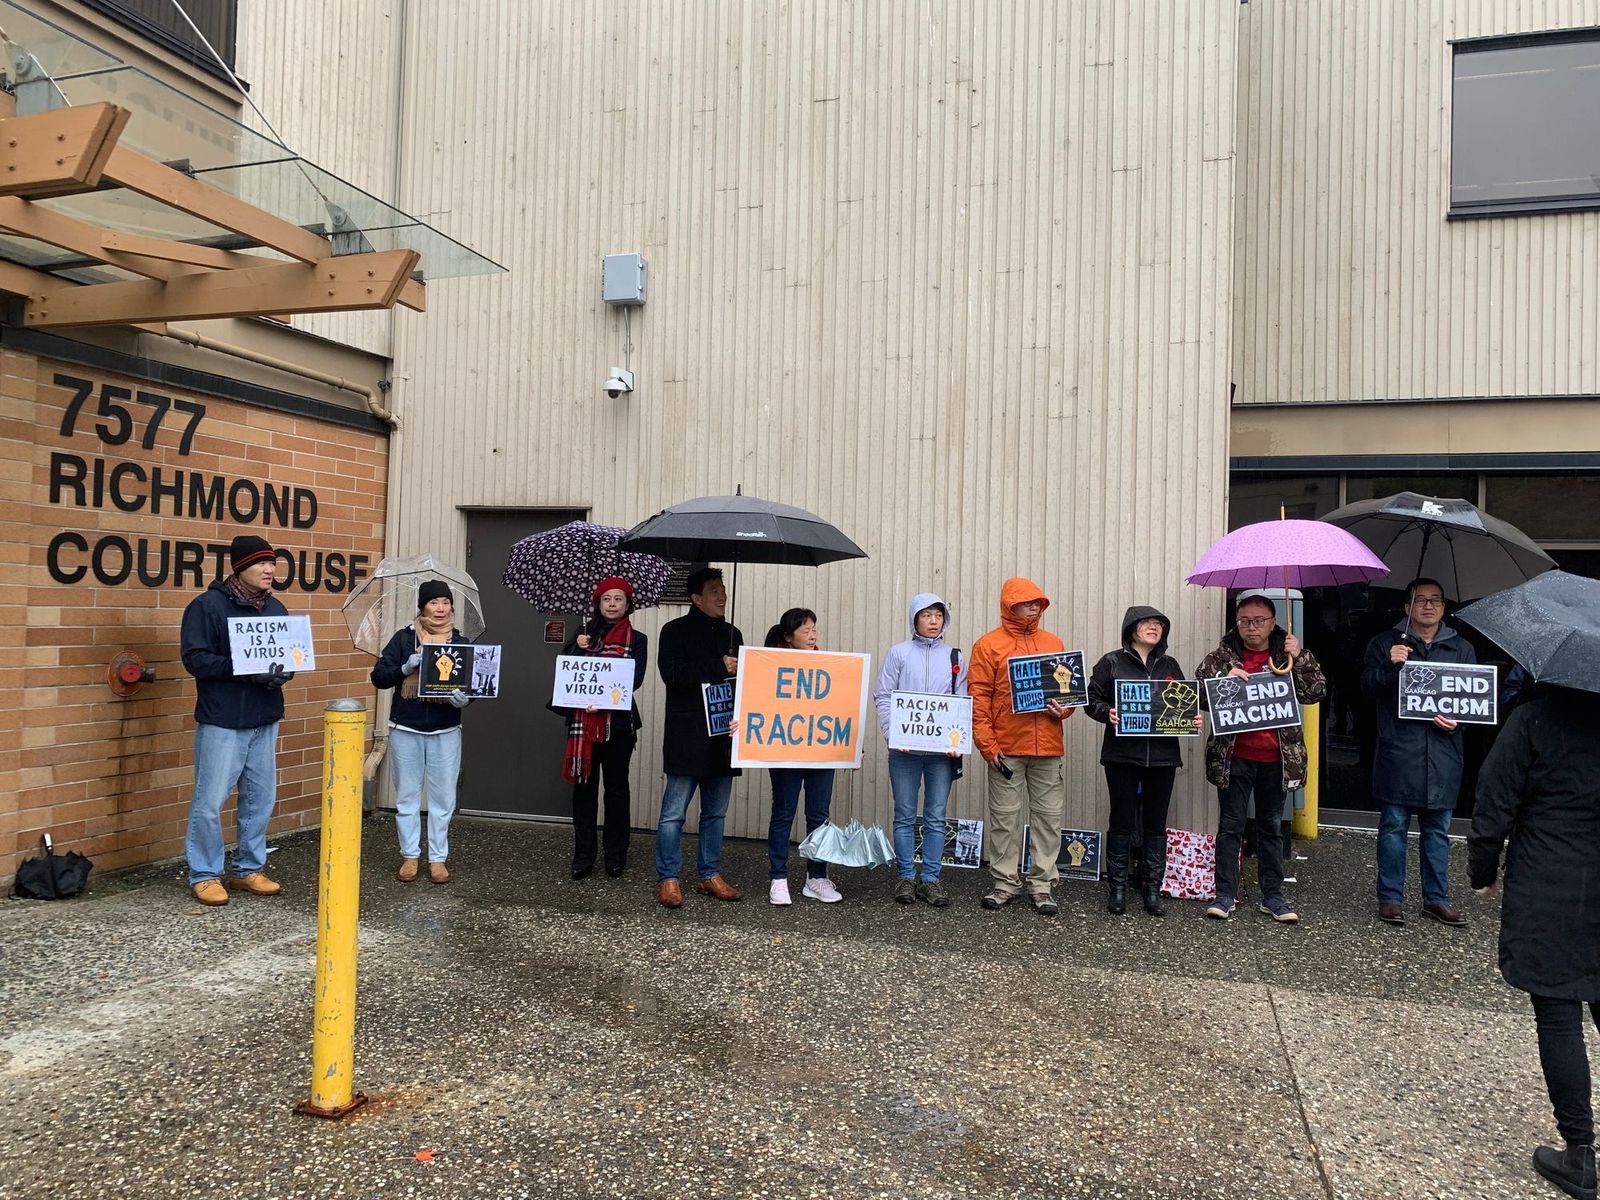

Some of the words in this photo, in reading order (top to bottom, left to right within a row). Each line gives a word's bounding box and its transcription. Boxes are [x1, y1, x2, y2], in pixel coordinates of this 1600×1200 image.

[53, 373, 206, 456] 7577
[49, 452, 318, 529] RICHMOND
[47, 531, 368, 593] COURTOUSE
[235, 622, 288, 634] RACISM
[250, 635, 262, 646] IS
[267, 634, 276, 645] A
[244, 647, 284, 659] VIRUS
[562, 660, 612, 672] RACISM
[1015, 662, 1040, 678] HATE
[573, 672, 585, 683] IS
[589, 673, 598, 683] A
[776, 667, 832, 700] END
[1441, 676, 1489, 694] END
[565, 684, 604, 695] VIRUS
[709, 685, 731, 701] HATE
[1123, 684, 1150, 700] HATE
[1245, 681, 1289, 701] END
[896, 698, 949, 712] RACISM
[1018, 692, 1043, 708] VIRUS
[1130, 703, 1136, 712] IS
[1137, 703, 1142, 711] A
[1406, 695, 1489, 716] RACISM
[910, 711, 921, 723] IS
[926, 712, 935, 724] A
[1218, 701, 1294, 727] RACISM
[746, 712, 852, 747] RACISM
[901, 723, 943, 737] VIRUS
[1123, 716, 1150, 730] VIRUS
